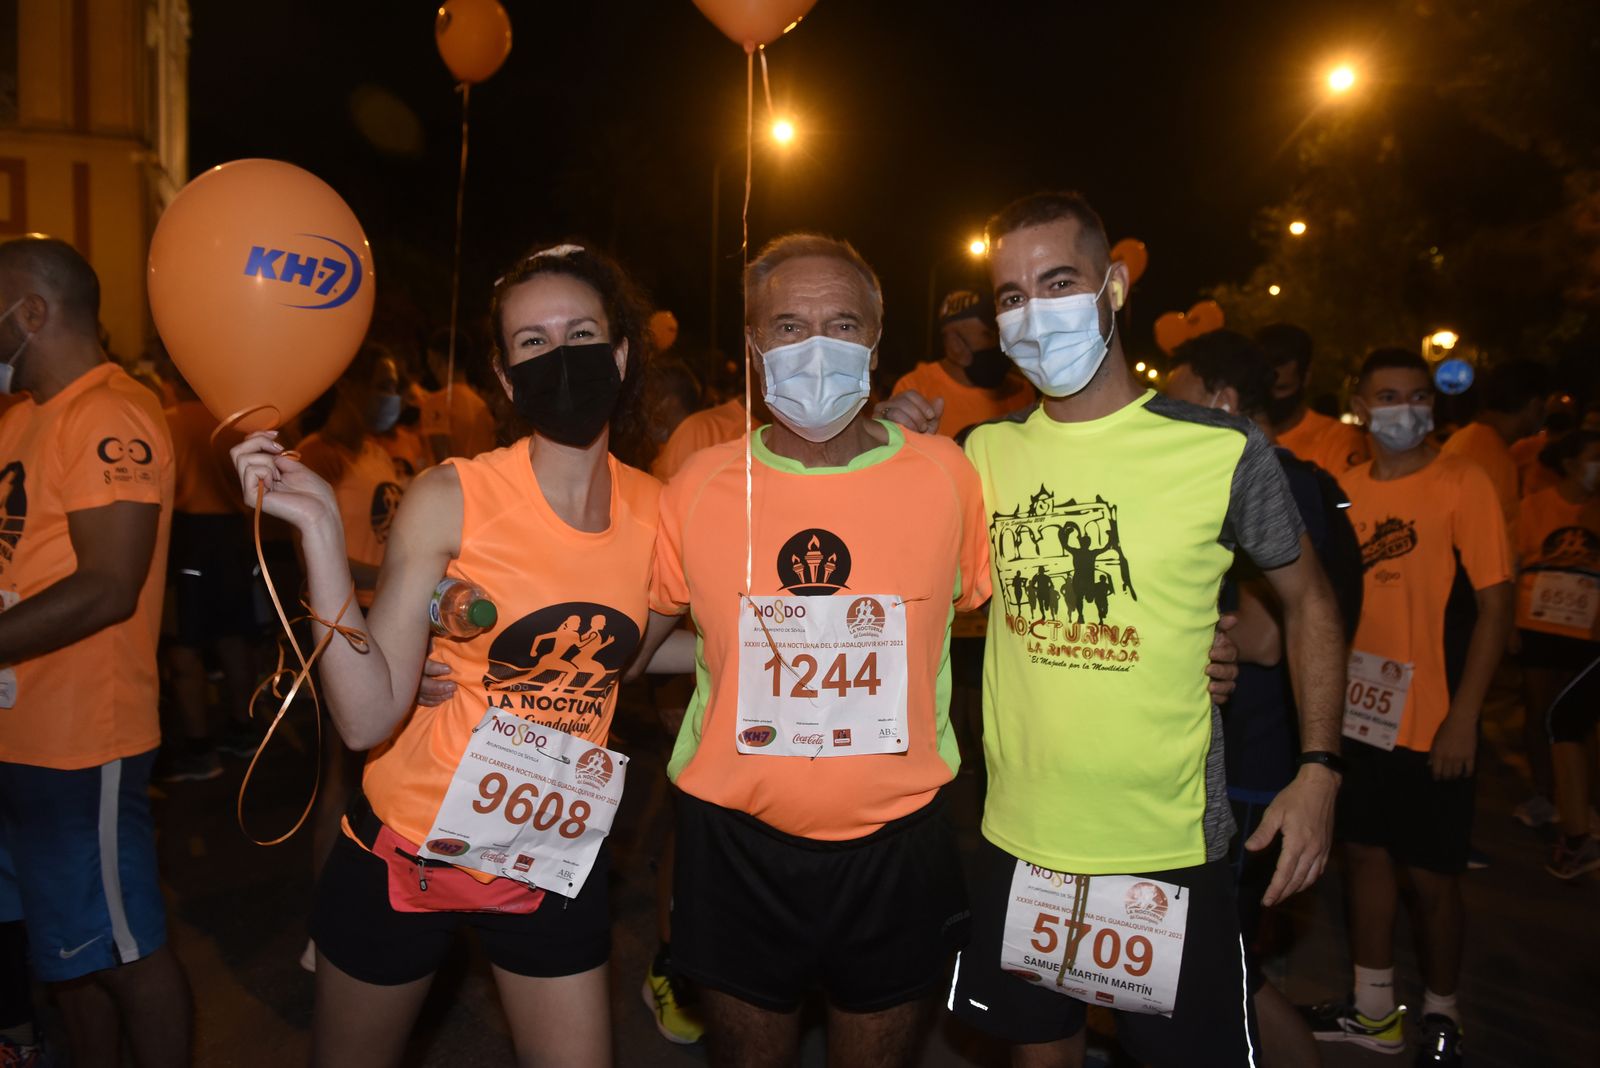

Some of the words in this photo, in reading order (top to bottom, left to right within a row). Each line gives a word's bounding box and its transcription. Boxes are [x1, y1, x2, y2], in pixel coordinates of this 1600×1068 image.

[834, 640, 877, 649] GUADALQUIVIR
[1005, 615, 1140, 648] NOCTURNA
[1028, 640, 1043, 654] LA
[1047, 642, 1139, 662] RINCONADA
[764, 652, 881, 698] 1244
[1069, 662, 1081, 670] por
[1082, 662, 1090, 670] la
[487, 694, 514, 709] LA
[1348, 682, 1393, 715] 055
[792, 733, 825, 746] Coca-Cola
[879, 728, 898, 737] ABC
[470, 752, 488, 763] XXXIII
[488, 758, 515, 773] CARRERA
[515, 766, 547, 784] NOCTURNA
[547, 777, 557, 786] DEL
[556, 780, 596, 800] GUADALQUIVIR
[472, 772, 591, 839] 9608
[480, 849, 510, 864] Coca-Cola
[557, 868, 576, 880] ABC
[1016, 895, 1033, 906] XXXIII
[1034, 899, 1061, 914] CARRERA
[1095, 915, 1107, 924] DEL
[1108, 918, 1153, 935] GUADALQUIVIR
[1154, 928, 1168, 937] KH7
[1168, 931, 1183, 940] 2021
[1030, 912, 1153, 977] 5709
[1023, 955, 1064, 973] SAMUE
[1069, 966, 1109, 985] MARTÍN
[1111, 978, 1153, 996] MARTÍN
